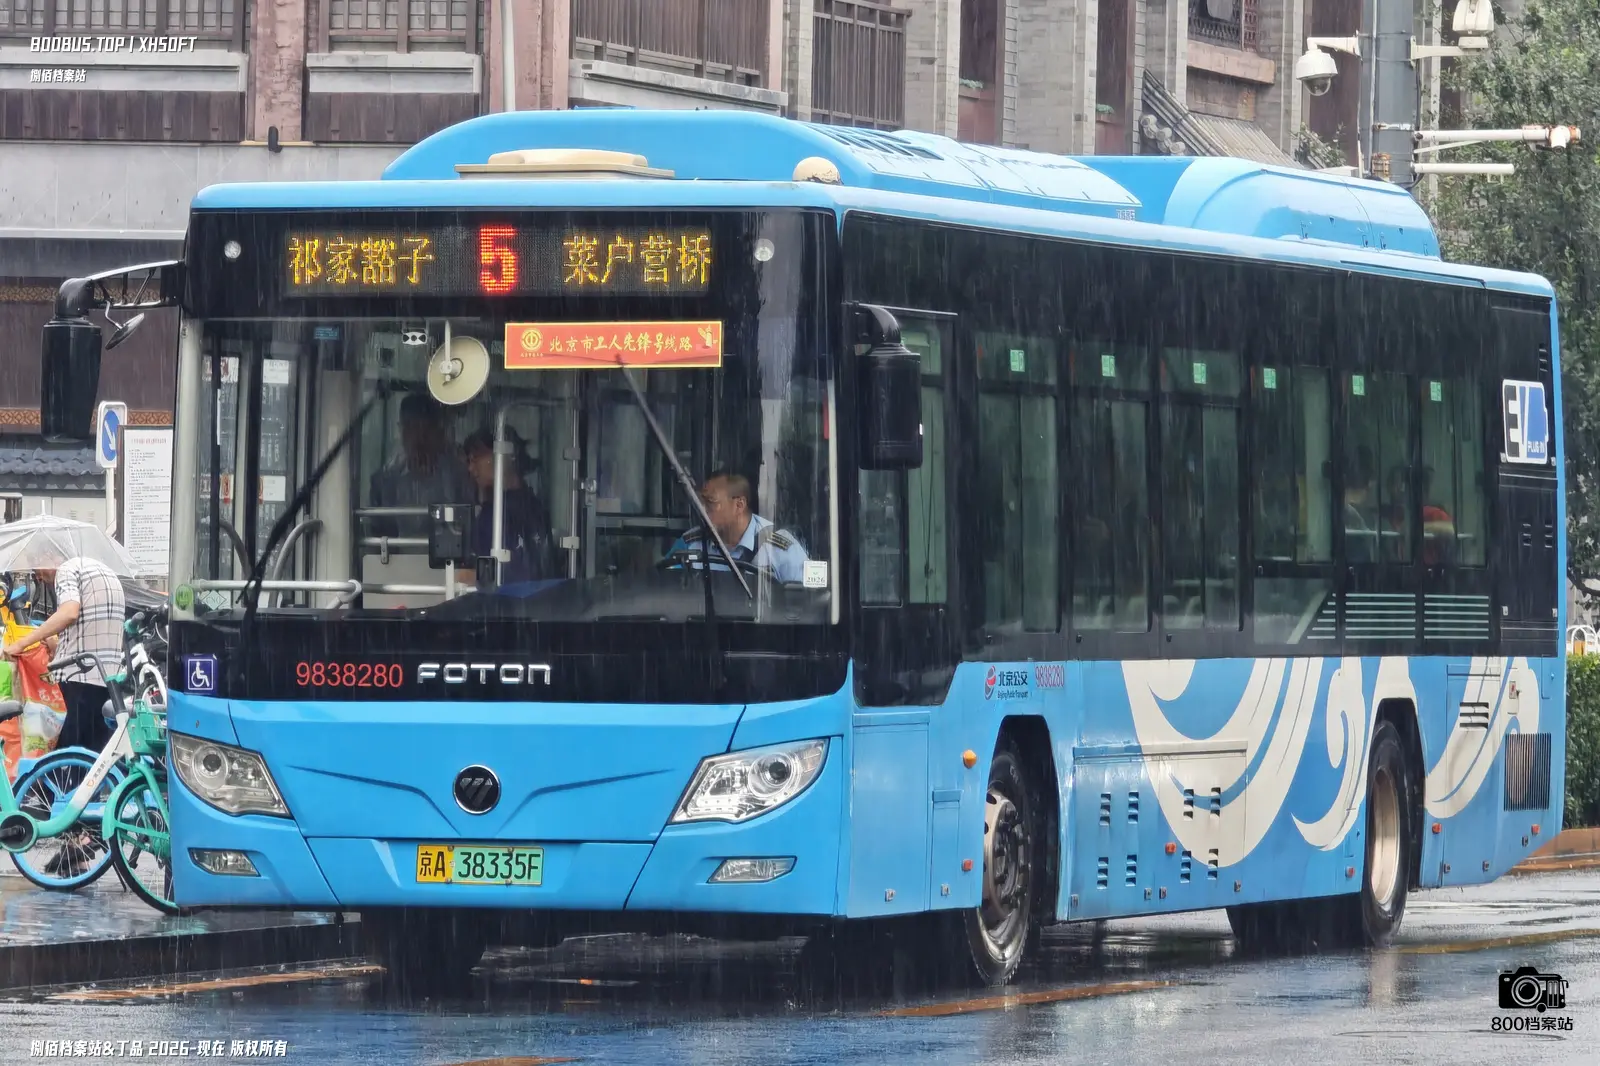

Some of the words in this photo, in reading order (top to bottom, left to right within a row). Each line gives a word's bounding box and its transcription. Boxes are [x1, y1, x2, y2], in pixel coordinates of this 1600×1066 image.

[479, 225, 517, 292] 5
[563, 234, 711, 285] 菜户营桥
[549, 331, 693, 355] 北京市工人先锋号线路
[296, 662, 403, 688] 9838280
[416, 663, 551, 685] FOTON
[998, 671, 1028, 687] 北京公交
[419, 851, 446, 877] 京A
[458, 852, 541, 880] 38335F
